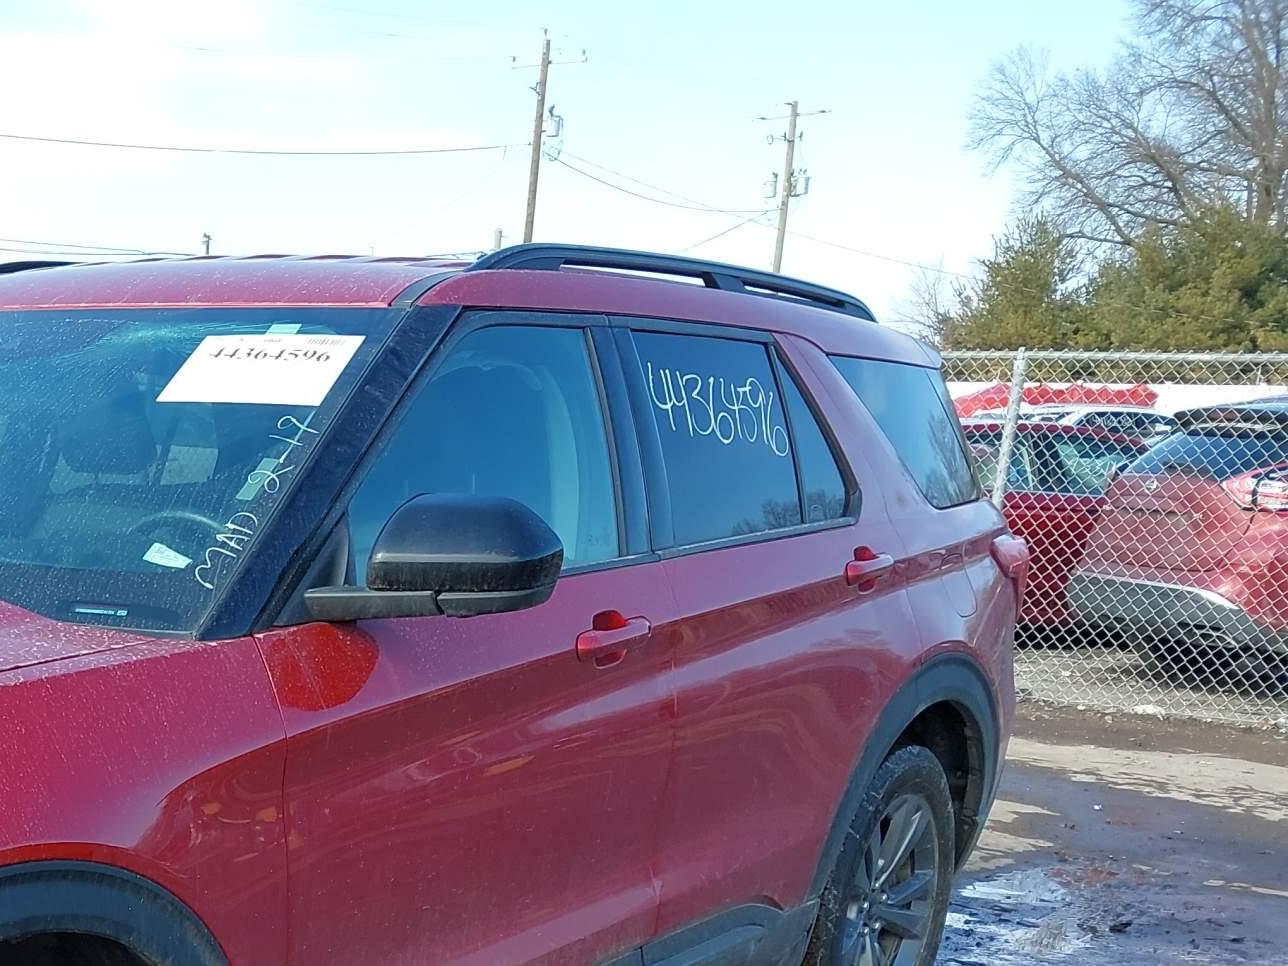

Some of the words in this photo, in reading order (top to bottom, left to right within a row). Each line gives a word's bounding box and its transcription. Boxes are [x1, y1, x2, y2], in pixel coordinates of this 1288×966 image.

[209, 347, 331, 363] 44364596
[647, 362, 789, 457] 44364596
[194, 511, 259, 590] MAD
